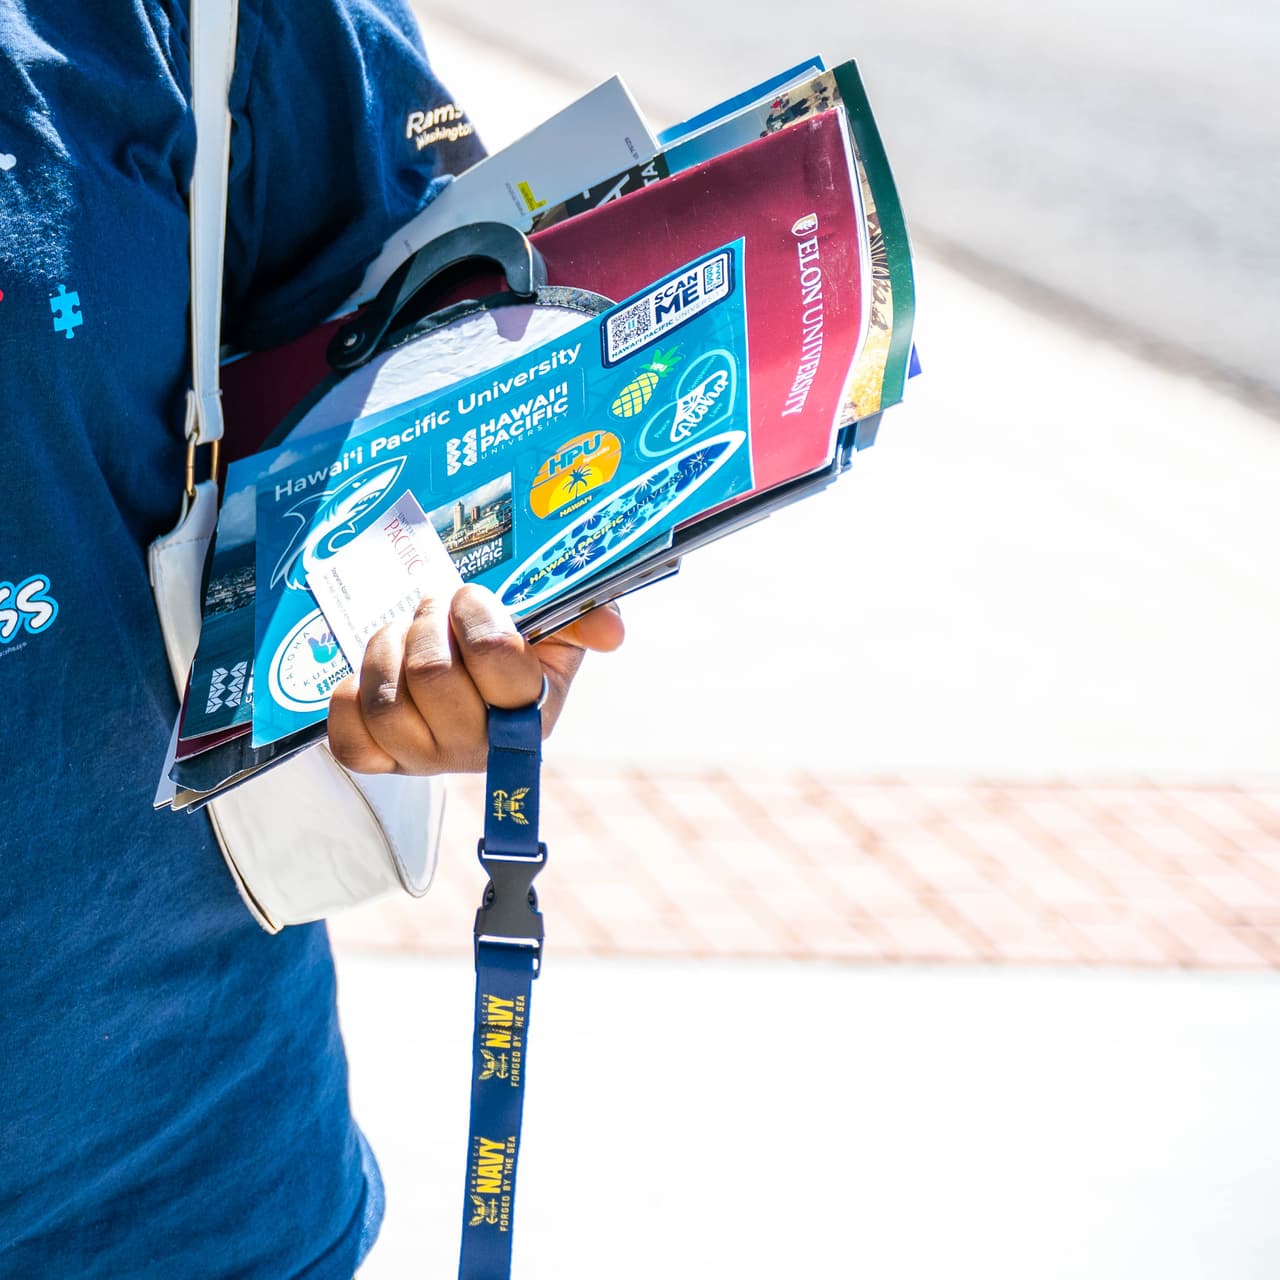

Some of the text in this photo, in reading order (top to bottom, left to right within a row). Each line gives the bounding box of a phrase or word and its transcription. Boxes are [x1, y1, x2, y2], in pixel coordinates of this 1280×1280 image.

[654, 271, 699, 306] SCAN
[655, 282, 700, 325] ME
[643, 319, 673, 341] PACIFIC
[781, 235, 824, 418] ELON UNIVERSITY
[370, 410, 451, 458] Pacific
[457, 343, 582, 416] University
[480, 397, 569, 454] PACIFIC
[678, 377, 729, 438] Aloha
[481, 410, 569, 460] UNIVERSITY
[547, 433, 604, 478] HPU
[576, 515, 625, 552] PACIFIC
[623, 458, 706, 518] UNIVERSITY
[383, 518, 425, 577] PACIFIC
[459, 547, 504, 575] ACIFIC
[285, 631, 311, 682] ALOHA
[485, 994, 515, 1049] NAVY
[510, 995, 526, 1087] FORGED BY HE SEA
[476, 1136, 506, 1194] NAVY
[499, 1135, 517, 1232] FORGED BY THE SEA
